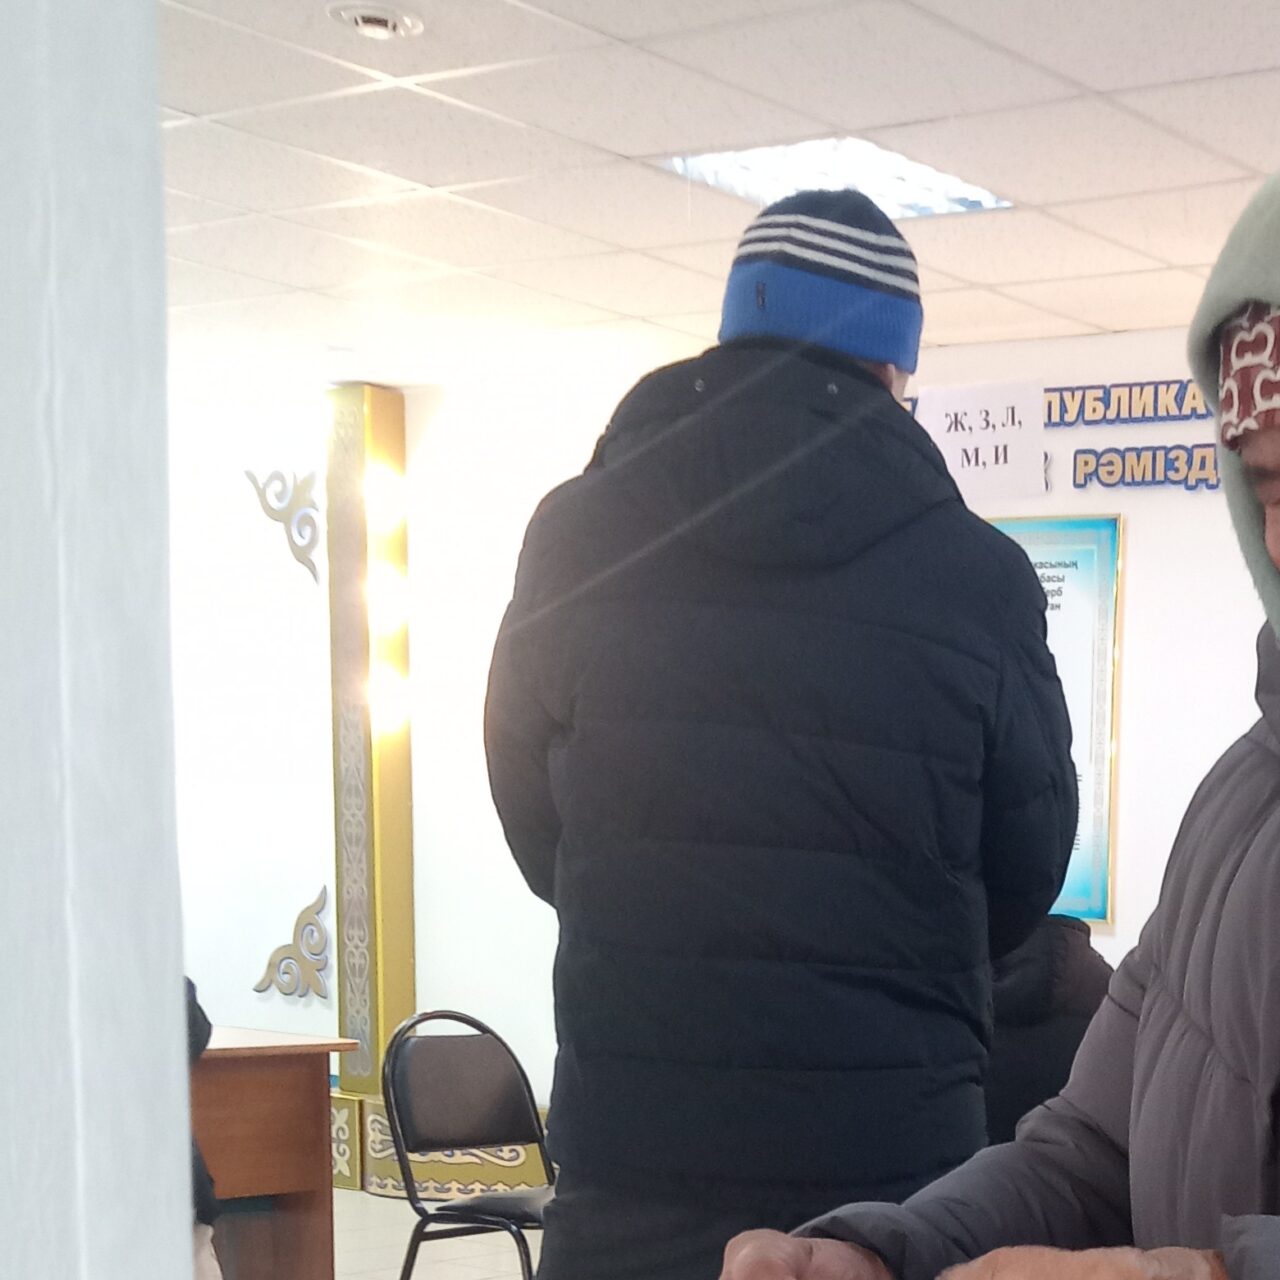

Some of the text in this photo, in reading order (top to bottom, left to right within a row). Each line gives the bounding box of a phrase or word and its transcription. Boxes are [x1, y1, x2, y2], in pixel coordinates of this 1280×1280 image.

[945, 405, 1022, 434] Ж, З, Л,
[961, 444, 1008, 468] М, И
[1073, 443, 1220, 490] РӘМІЗД
